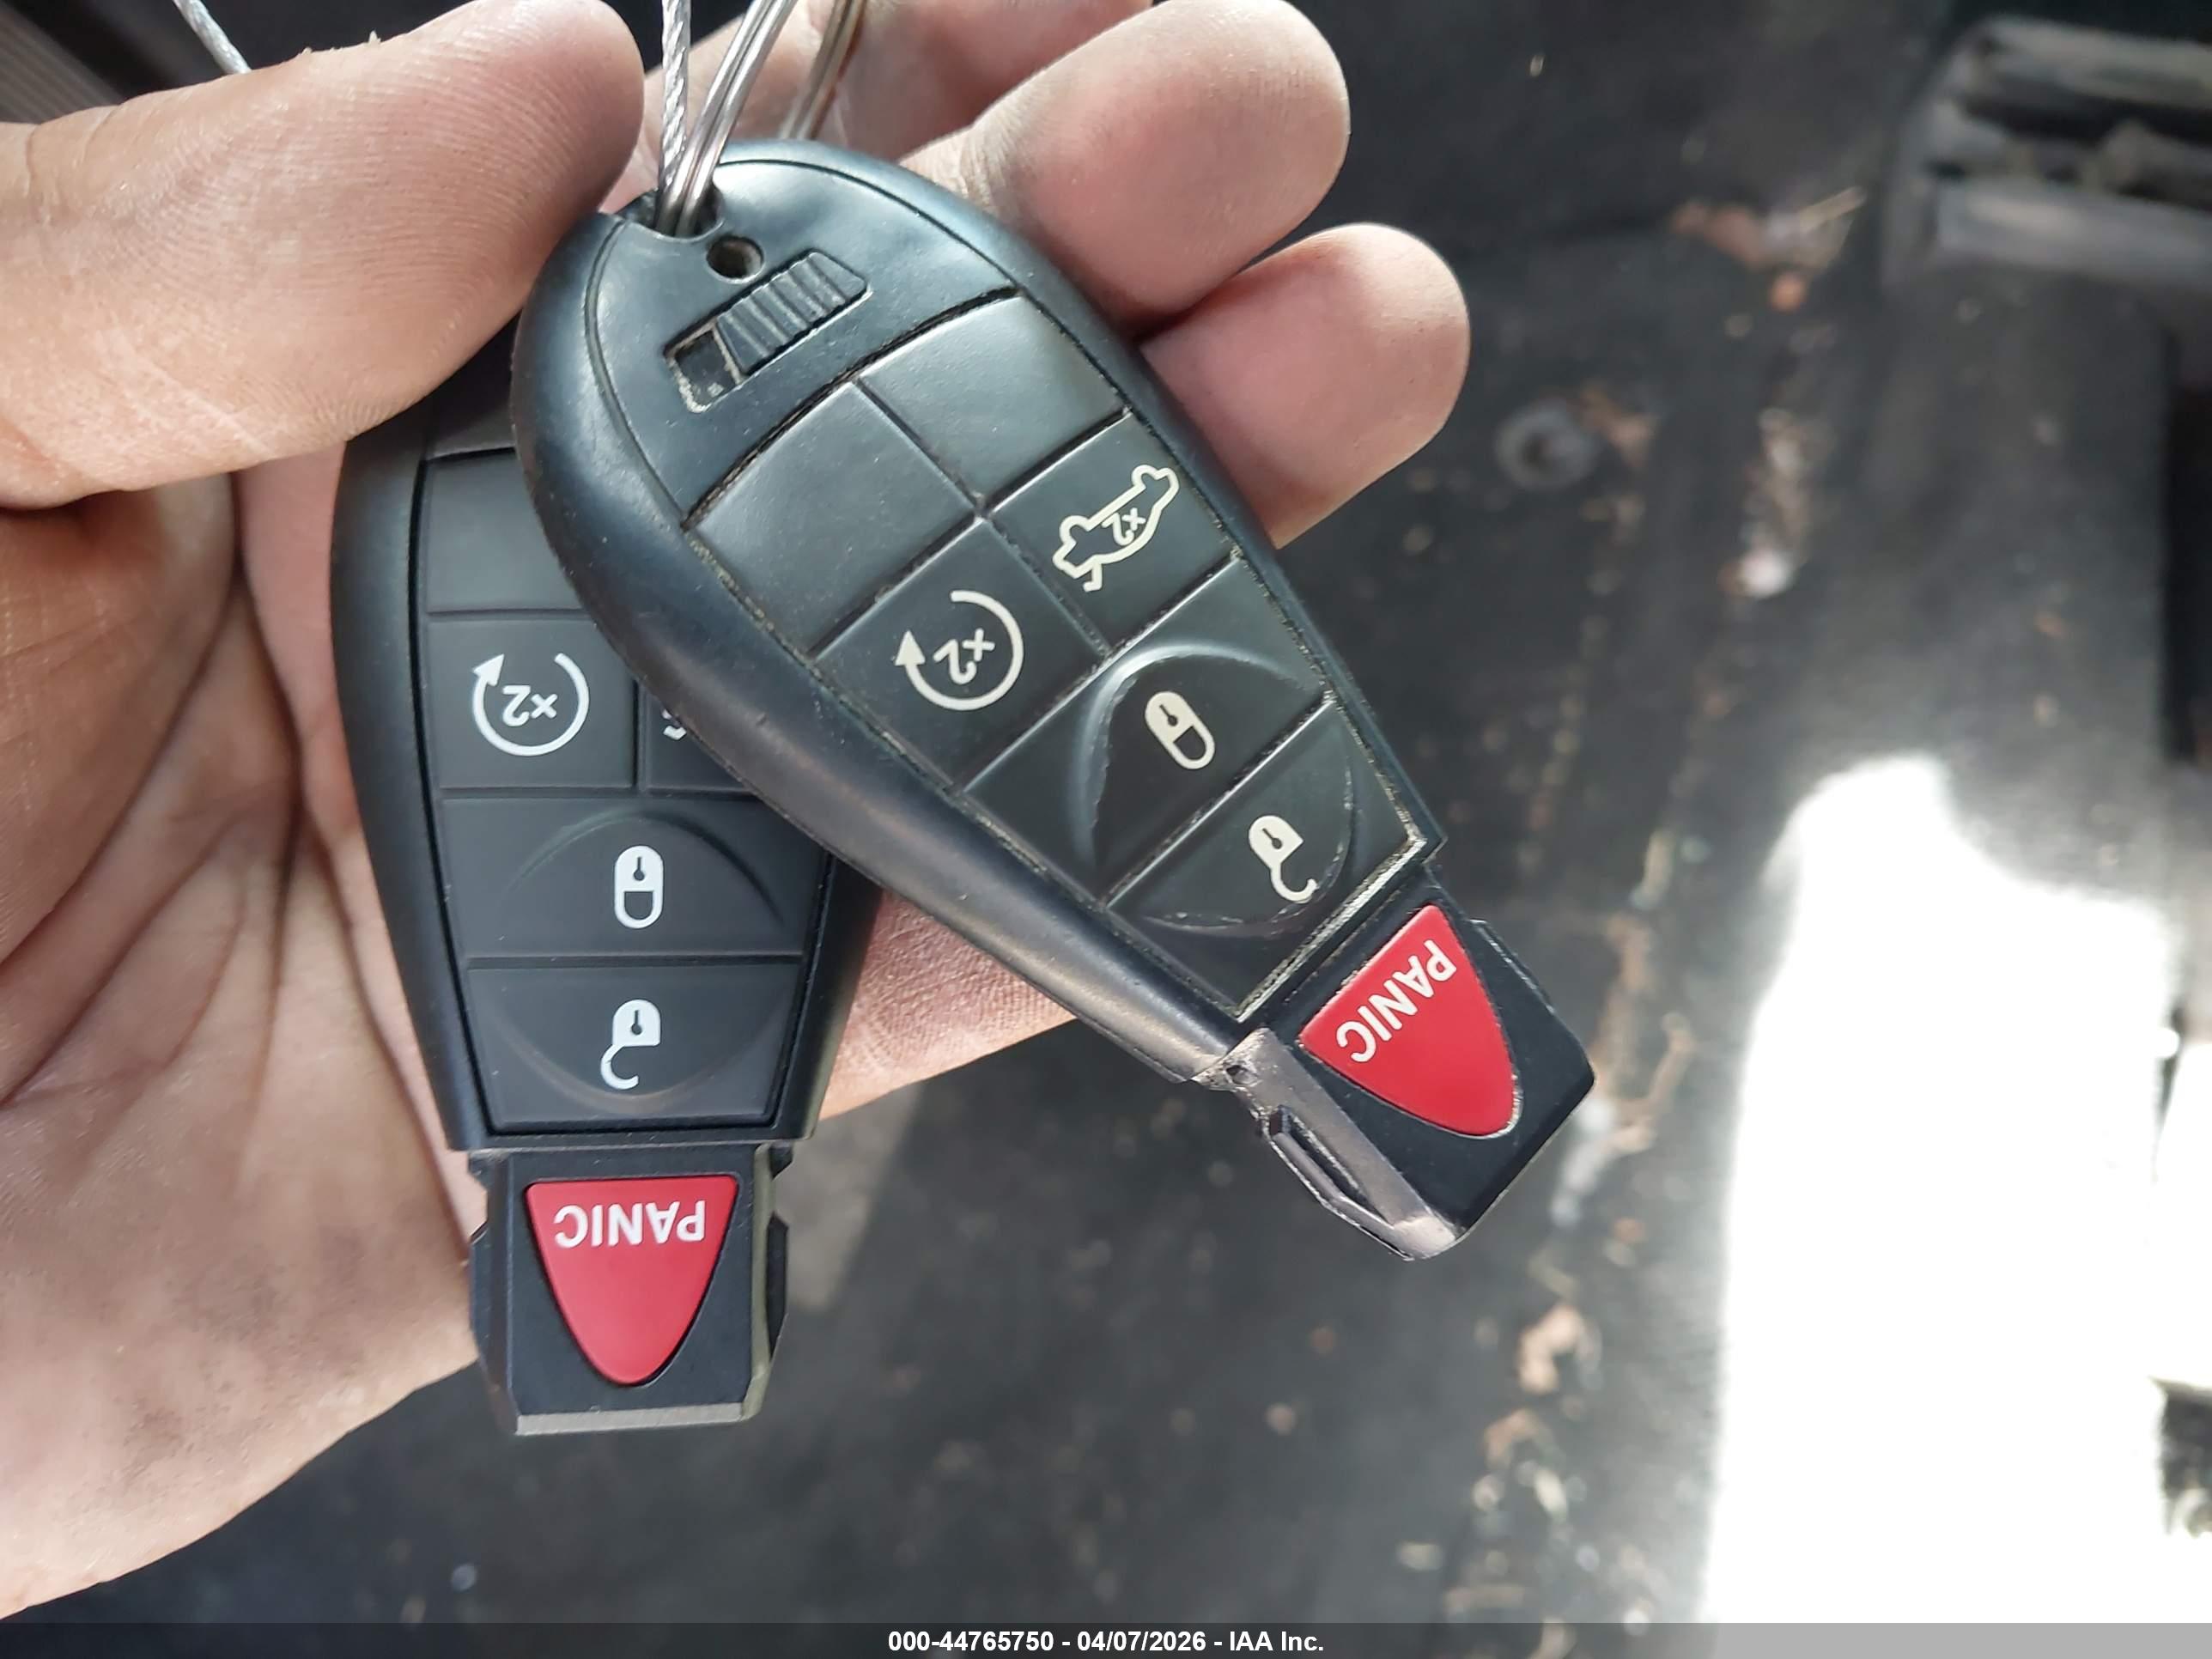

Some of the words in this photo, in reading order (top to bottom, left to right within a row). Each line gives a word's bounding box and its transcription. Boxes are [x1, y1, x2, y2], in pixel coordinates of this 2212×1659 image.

[933, 628, 996, 684] x2
[501, 684, 558, 727] x2
[1335, 939, 1457, 1063] PANIC
[553, 1200, 706, 1249] PANIC
